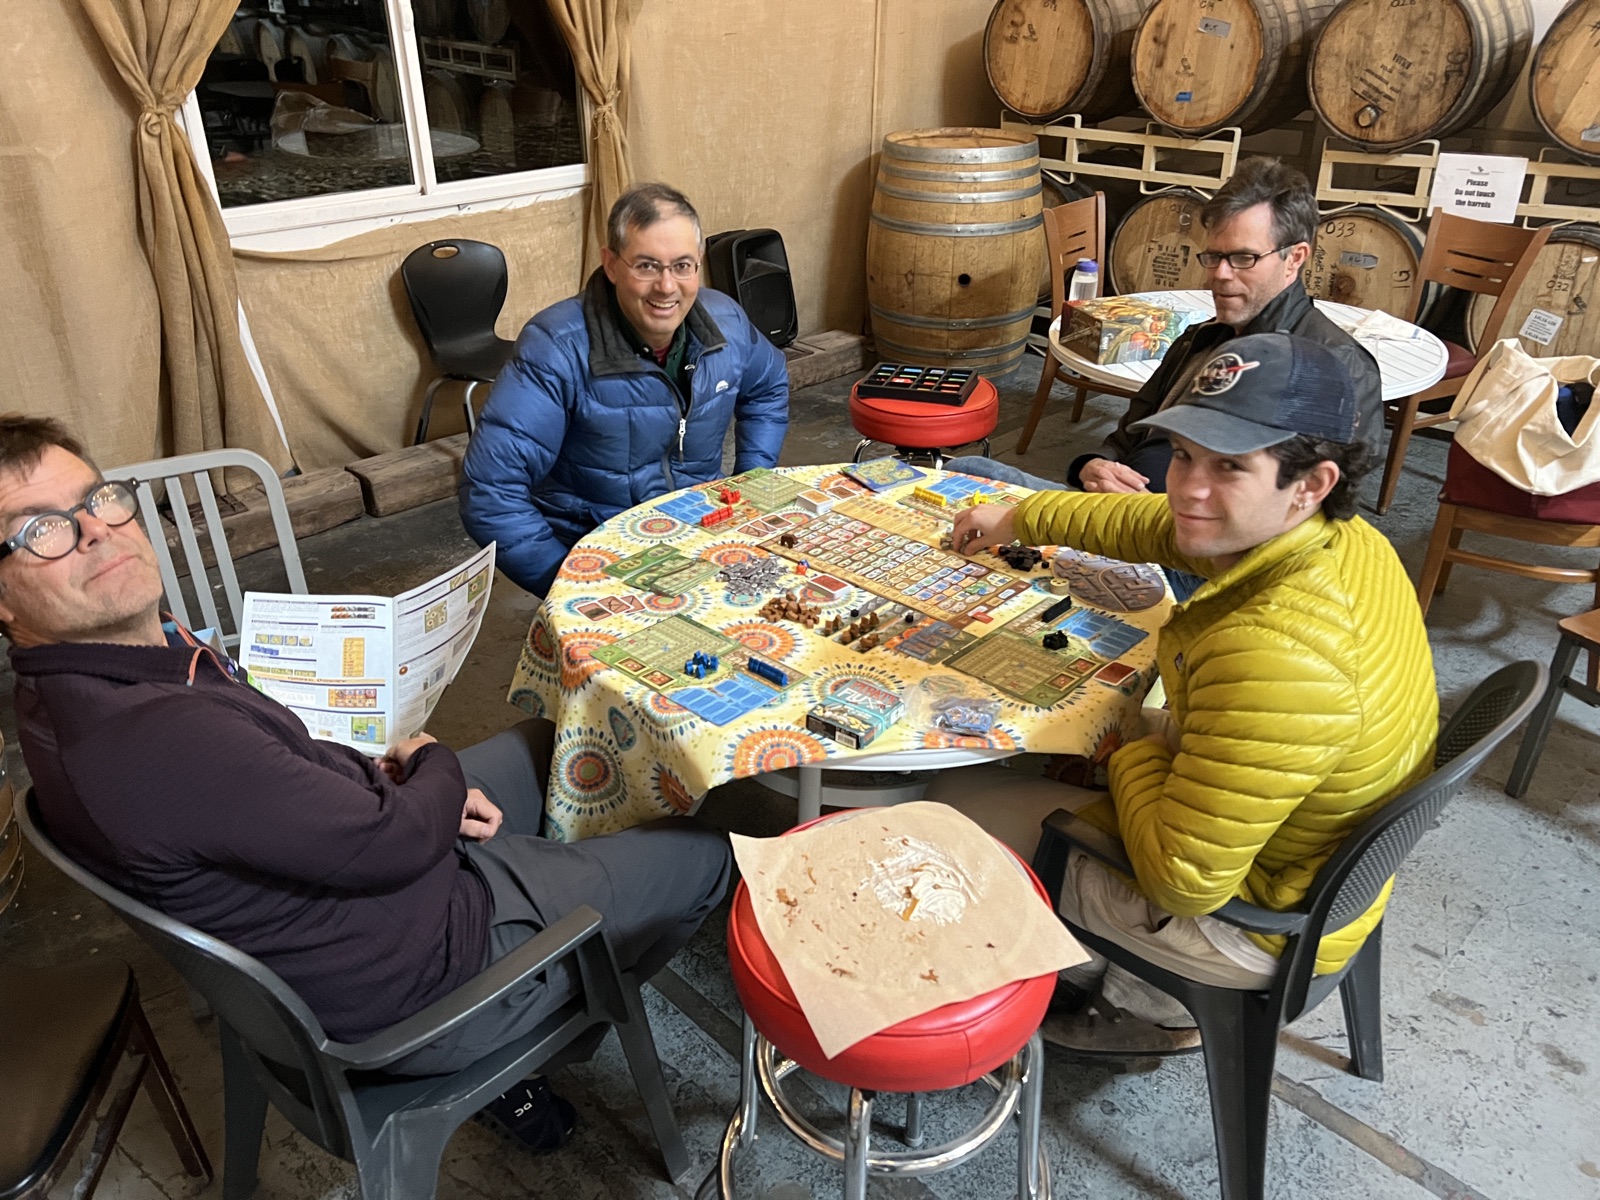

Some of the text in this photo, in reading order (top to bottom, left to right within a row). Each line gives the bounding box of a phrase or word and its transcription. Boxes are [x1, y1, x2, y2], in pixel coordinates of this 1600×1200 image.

[1466, 178, 1488, 187] Please
[1454, 188, 1464, 196] Do
[1476, 190, 1496, 198] touch
[1467, 200, 1491, 208] barrels
[1325, 221, 1356, 238] 033
[1546, 280, 1570, 292] 032
